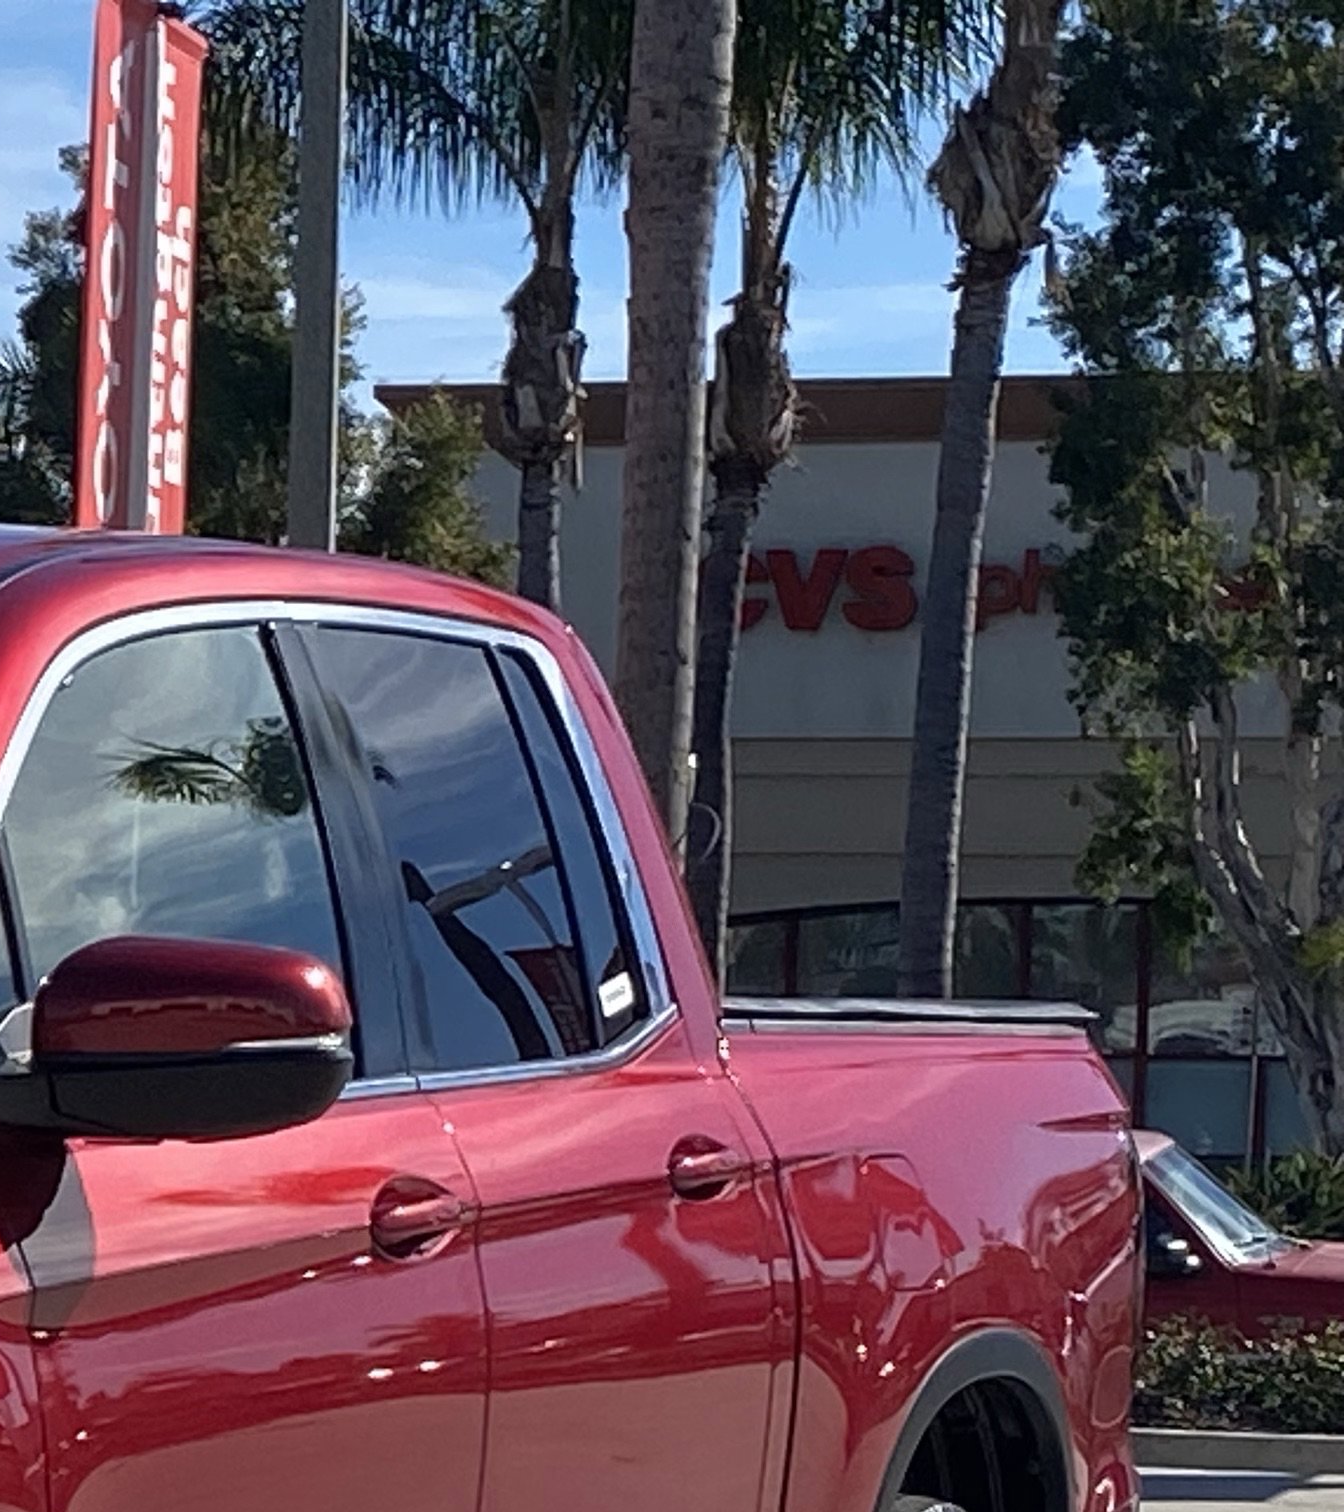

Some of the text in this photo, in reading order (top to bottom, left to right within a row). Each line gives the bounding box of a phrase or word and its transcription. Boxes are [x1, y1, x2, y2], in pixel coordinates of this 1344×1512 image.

[94, 39, 135, 526] OYOTA
[146, 60, 177, 534] untington
[164, 206, 192, 486] Beach
